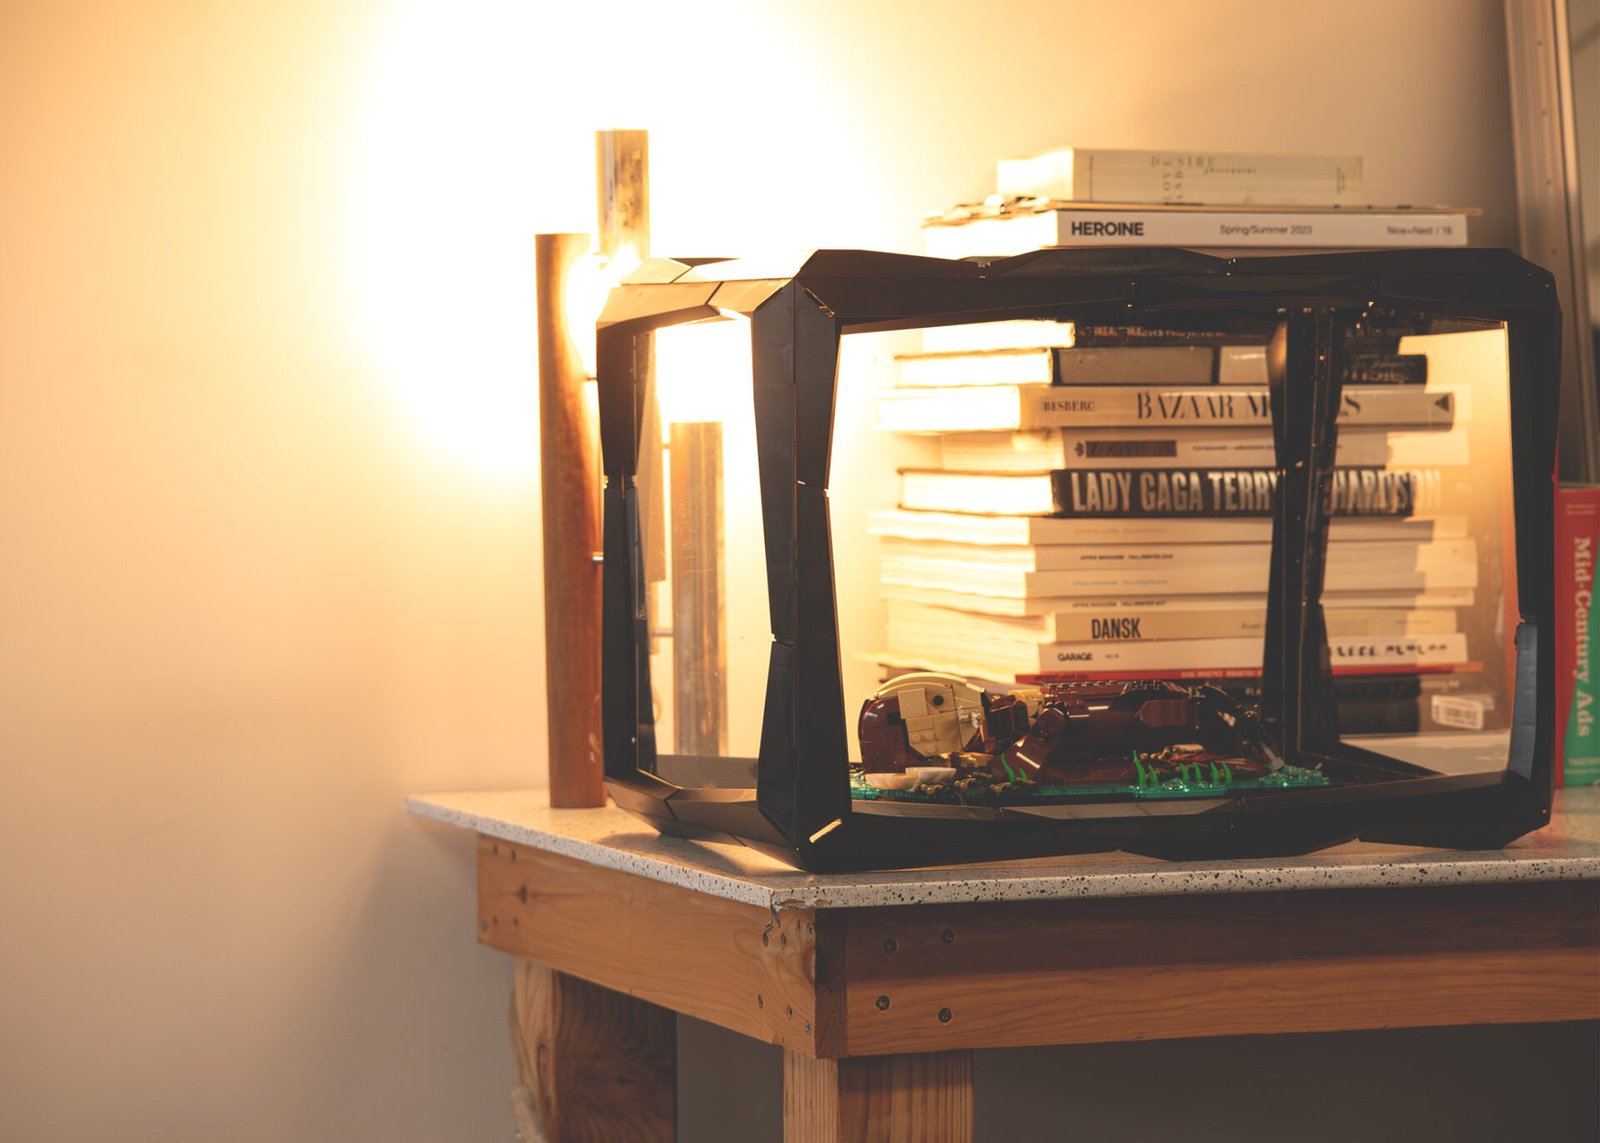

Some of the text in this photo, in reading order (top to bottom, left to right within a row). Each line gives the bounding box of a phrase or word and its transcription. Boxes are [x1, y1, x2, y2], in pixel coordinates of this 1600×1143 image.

[1071, 222, 1144, 236] HEROINE
[1219, 224, 1288, 236] Spring/Summer
[1137, 392, 1234, 419] BAZAAR
[1071, 472, 1132, 512] LADY
[1140, 471, 1204, 512] GAGA
[1091, 618, 1142, 640] DANSK
[1057, 653, 1092, 661] GARAGE
[1576, 689, 1594, 737] Ads
